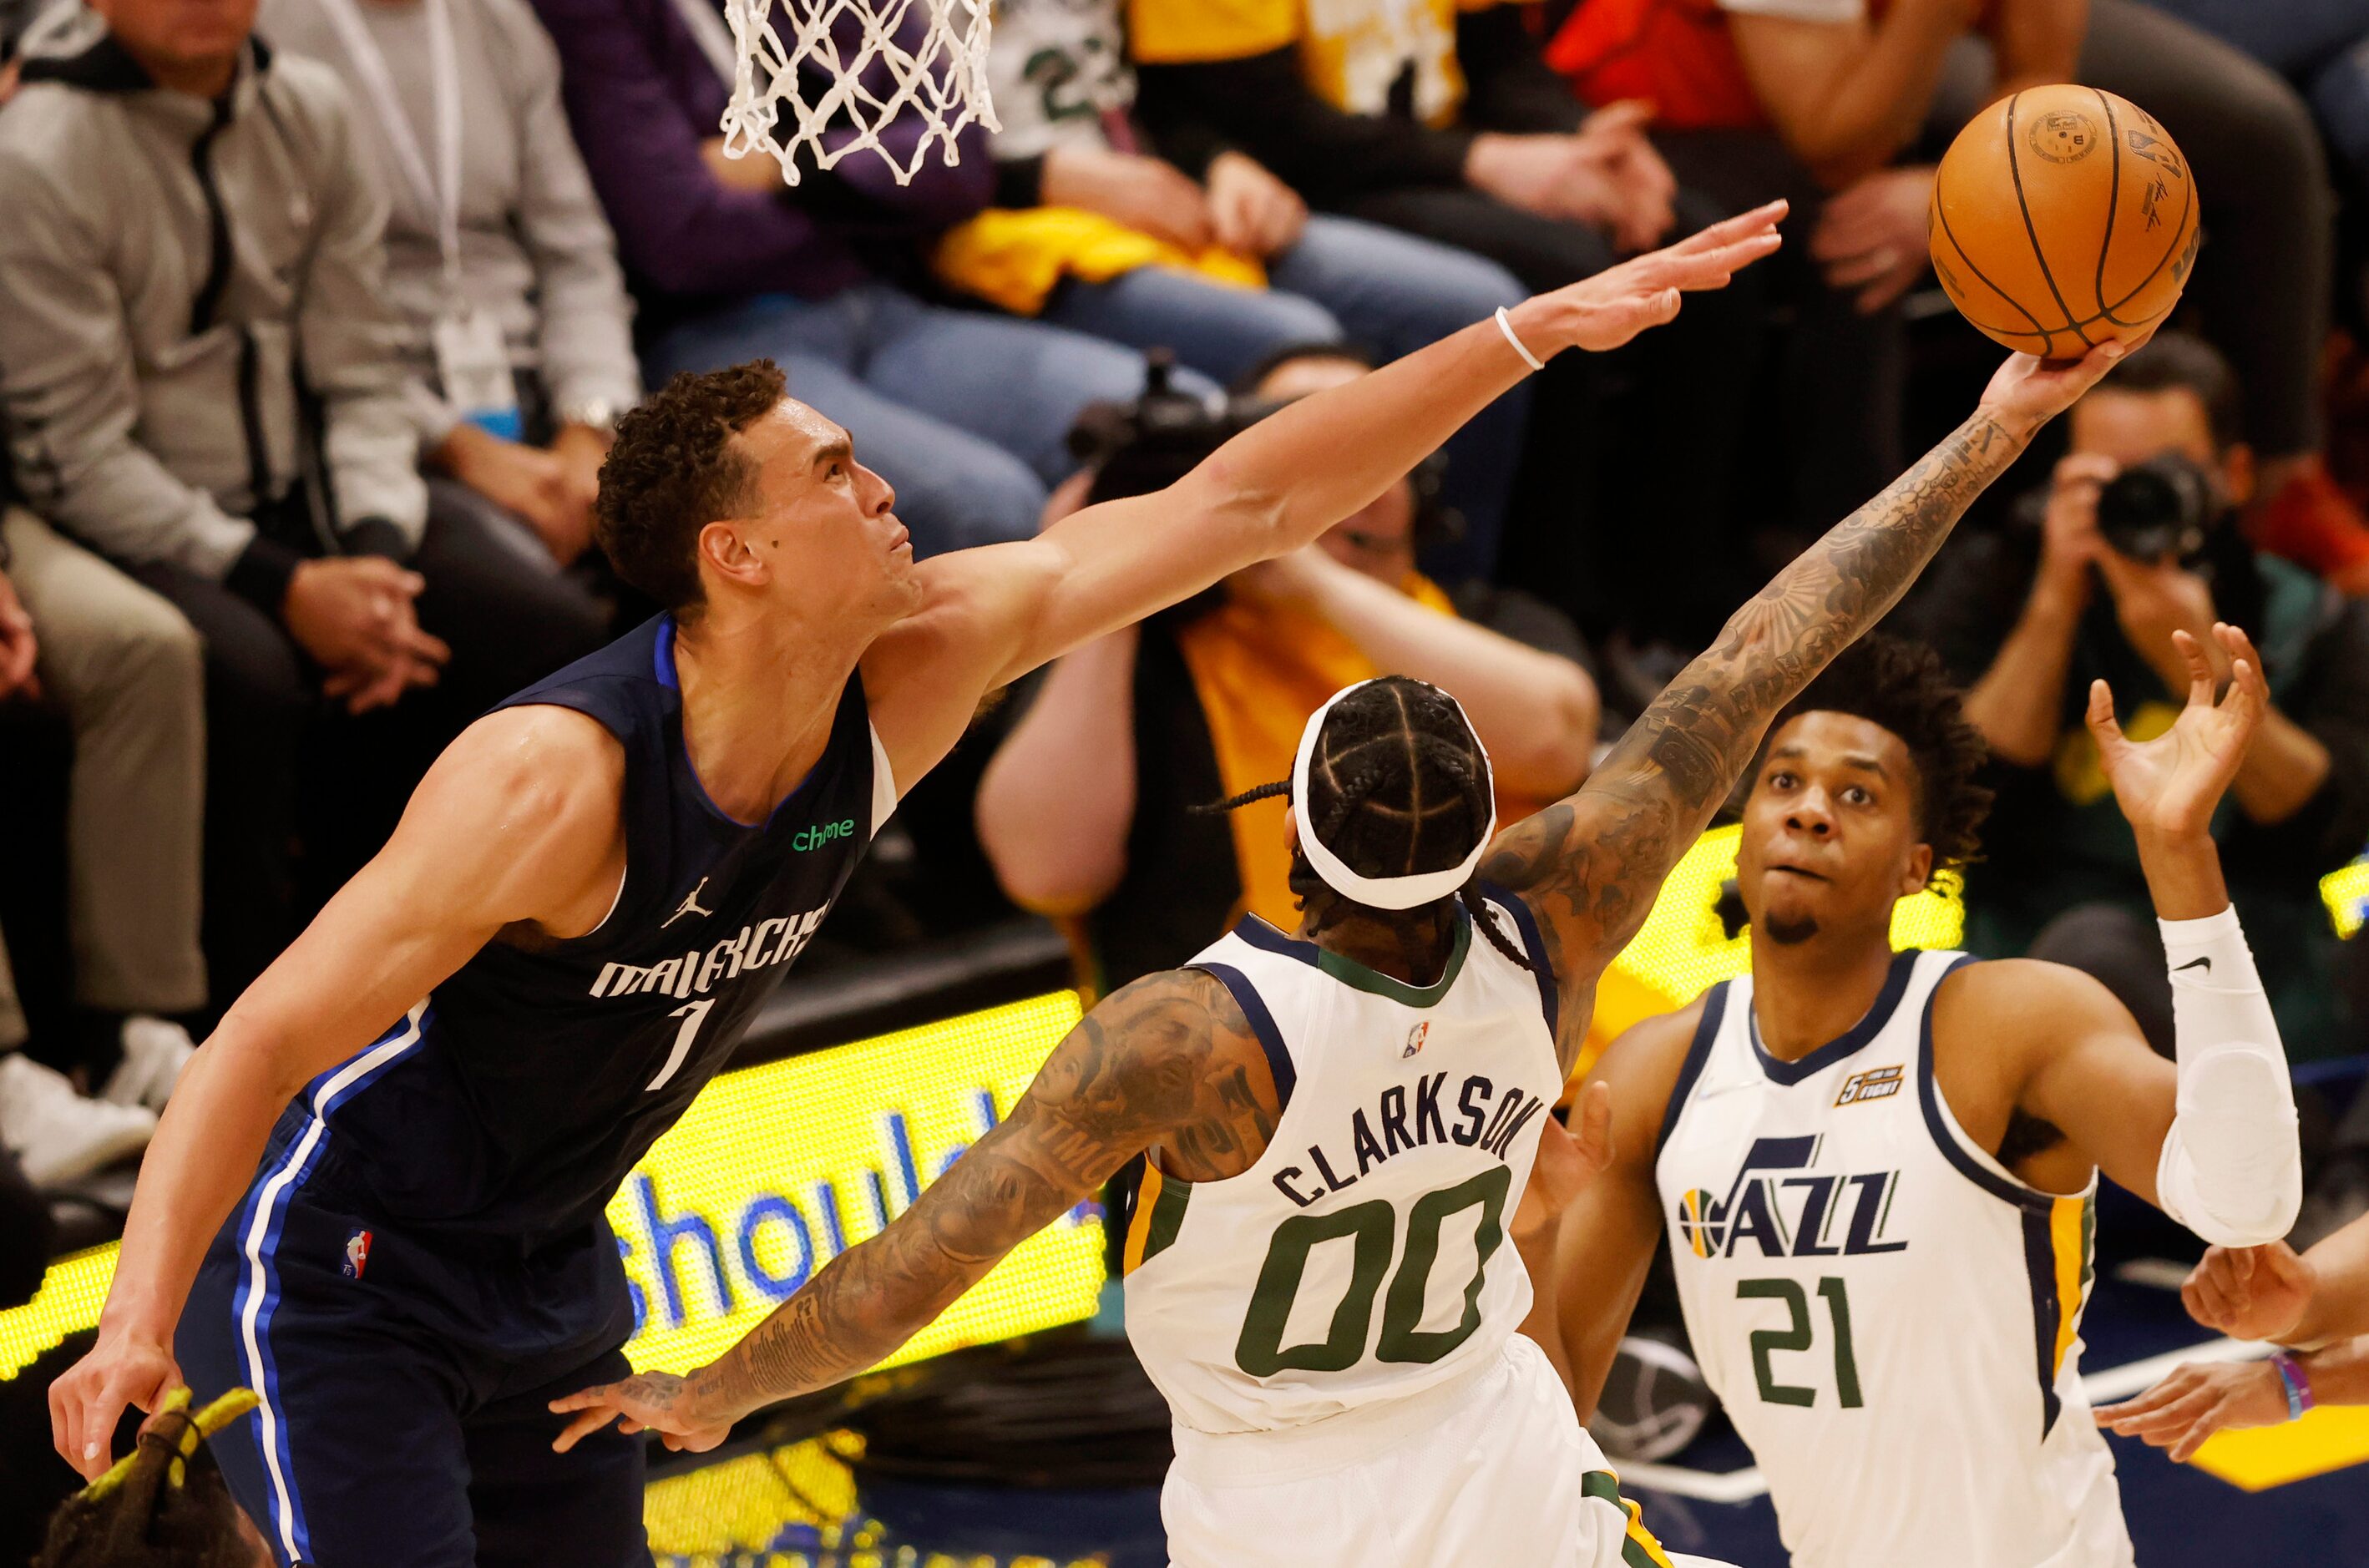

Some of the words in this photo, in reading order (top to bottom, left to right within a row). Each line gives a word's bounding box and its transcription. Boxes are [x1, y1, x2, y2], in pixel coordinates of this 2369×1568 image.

[792, 819, 855, 852] chme
[588, 898, 831, 999] MAVERCKS
[644, 998, 716, 1092] 7
[1272, 1071, 1544, 1208] CLARKSON
[1680, 1132, 1910, 1259] JAZZ
[1235, 1164, 1512, 1378] 00
[1736, 1276, 1864, 1409] 21
